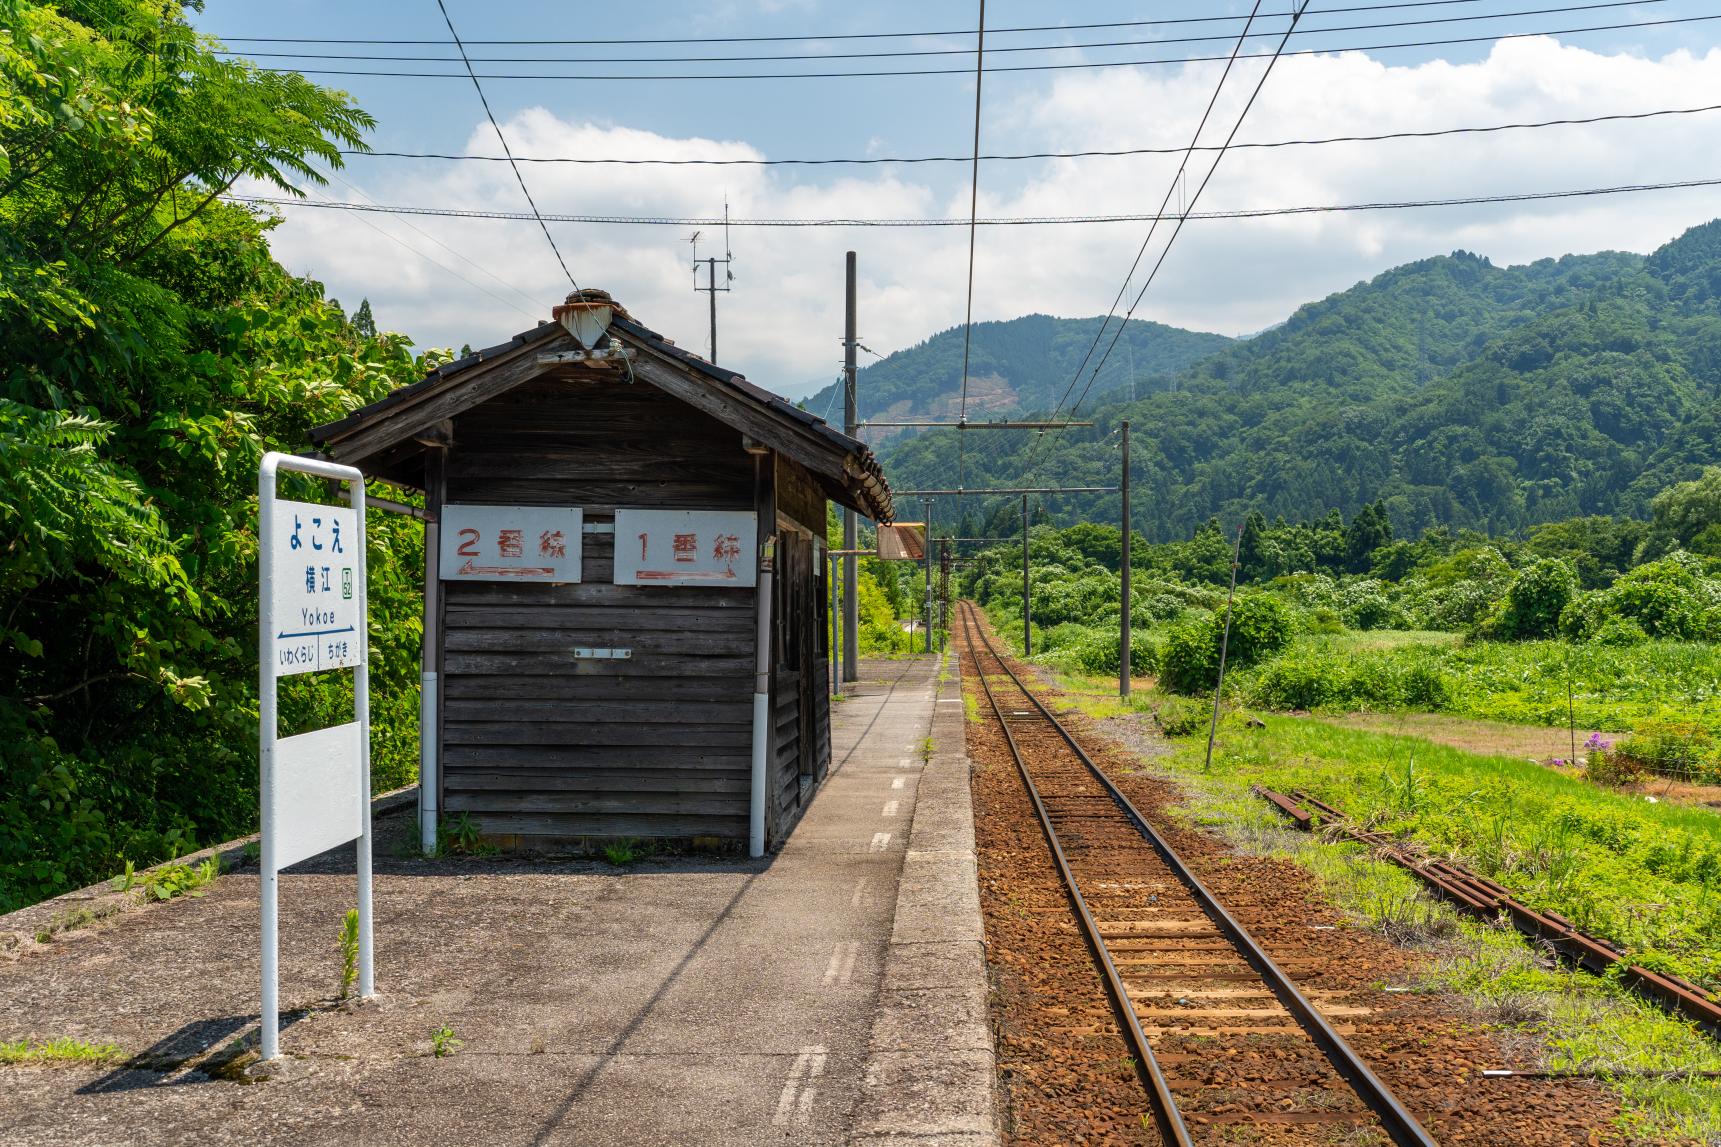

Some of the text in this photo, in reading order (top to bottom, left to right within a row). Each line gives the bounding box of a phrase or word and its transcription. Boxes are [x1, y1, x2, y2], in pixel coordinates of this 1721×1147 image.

[290, 514, 343, 554] よこえ
[305, 565, 331, 595] 横江
[343, 582, 351, 595] 52
[301, 607, 335, 626] Yokoe
[279, 644, 314, 666] いわくらじ
[327, 640, 348, 660] ちがき
